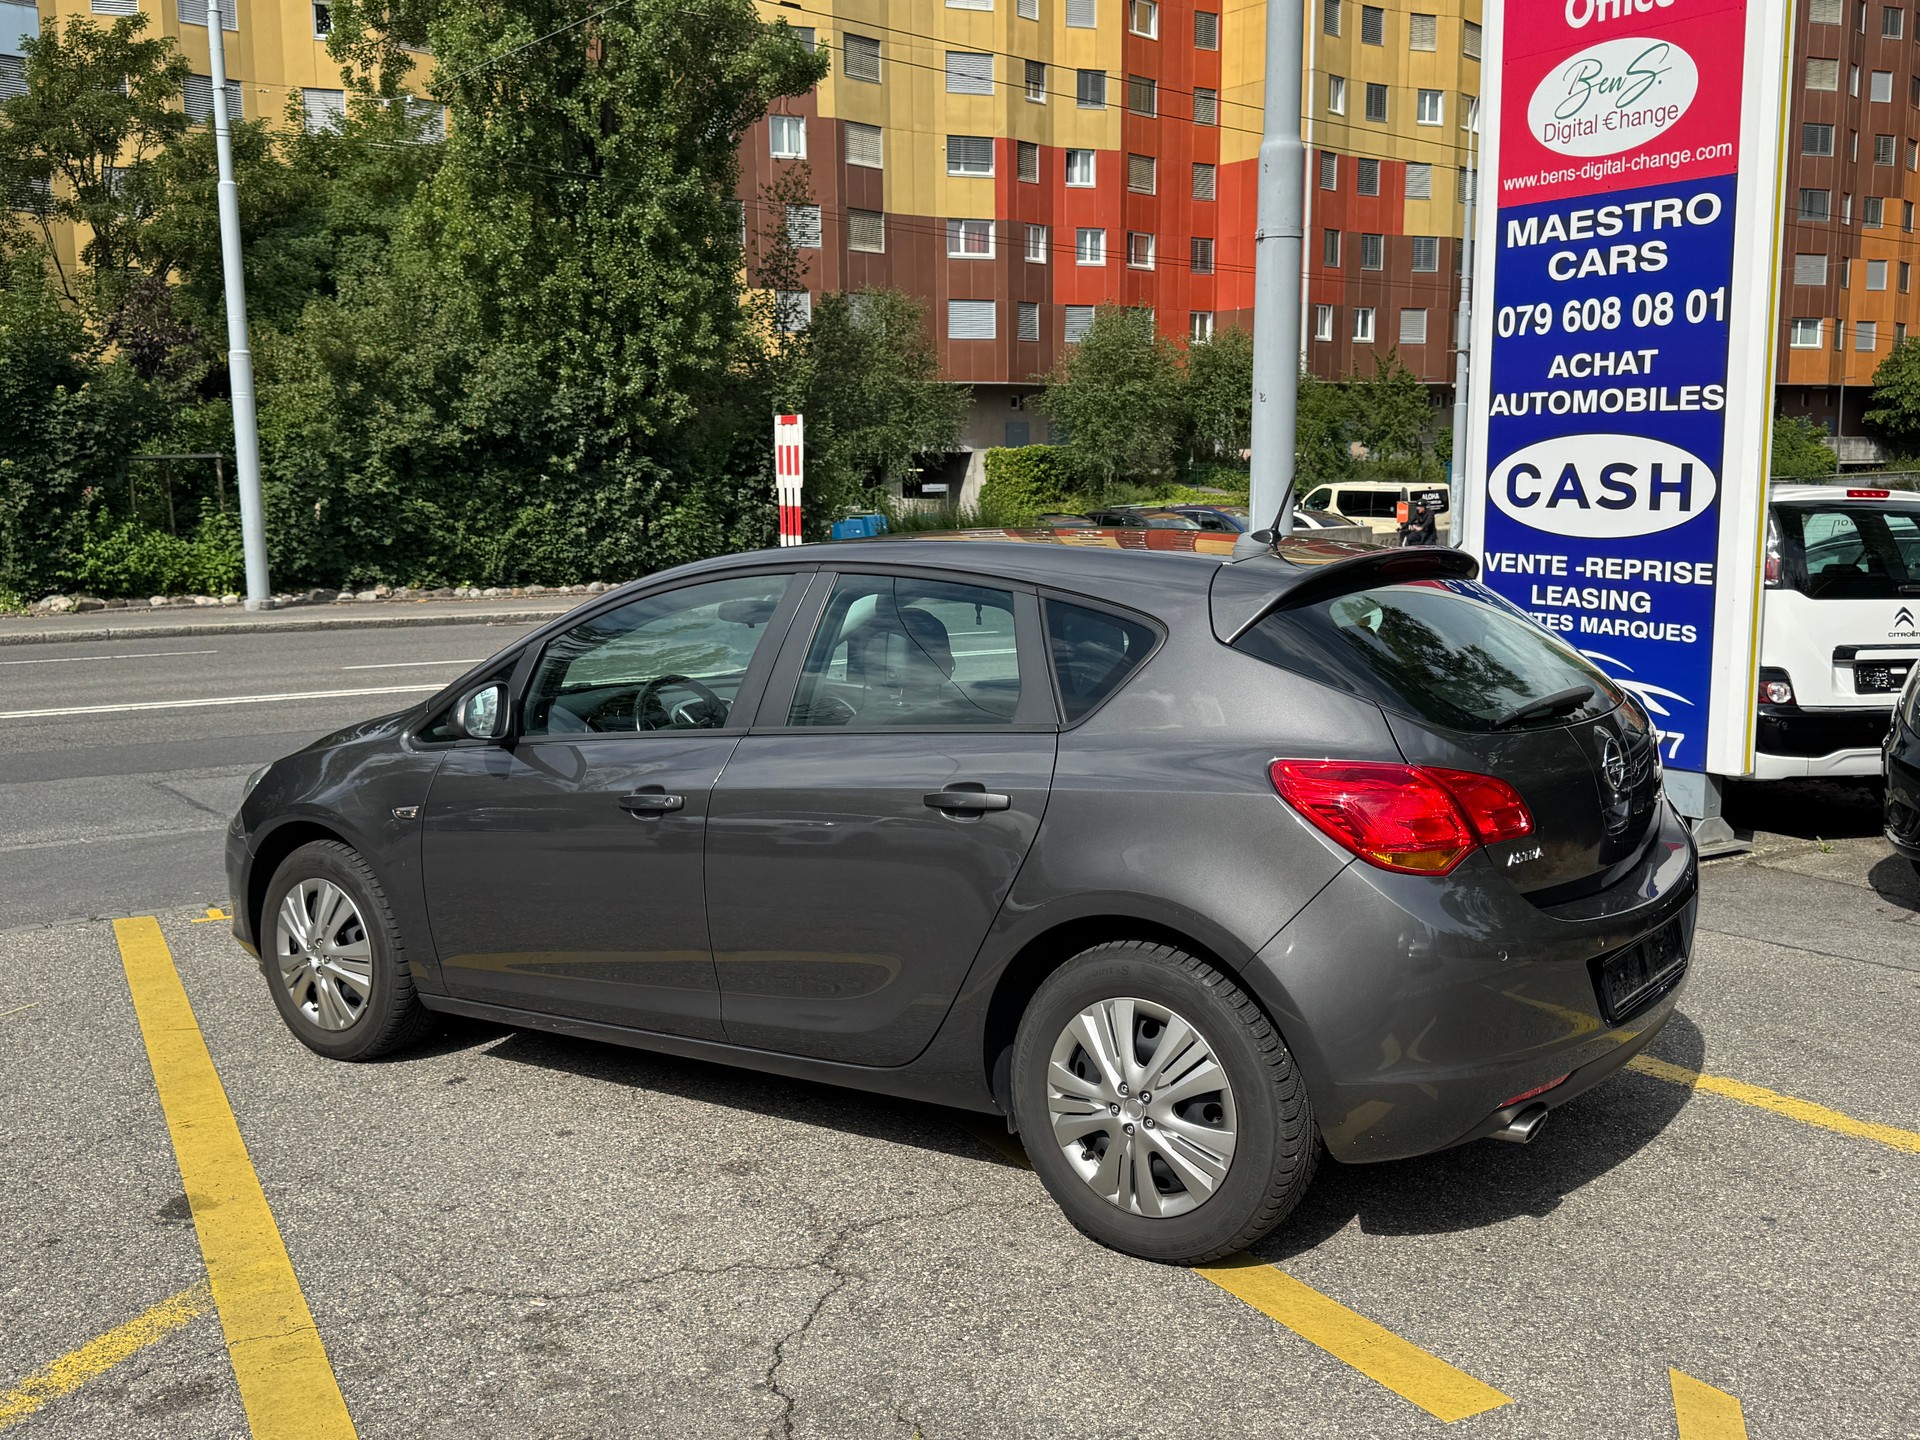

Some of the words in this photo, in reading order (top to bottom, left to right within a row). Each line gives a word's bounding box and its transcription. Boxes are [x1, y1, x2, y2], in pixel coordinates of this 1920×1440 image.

[1543, 115, 1598, 144] Digital
[1503, 142, 1733, 191] www.bens-digital-change.com
[1507, 193, 1722, 248] MAESTRO
[1548, 240, 1668, 281] CARS
[1498, 303, 1552, 338] 079
[1562, 296, 1621, 333] 608
[1632, 291, 1674, 328] 08
[1686, 287, 1725, 324] 01
[1547, 349, 1659, 379] ACHAT
[1489, 384, 1724, 417] AUTOMOBILES
[1506, 462, 1693, 512] CASH
[1485, 552, 1568, 576] VENTE
[1531, 585, 1651, 614] LEASING
[1580, 616, 1697, 643] MARQUES
